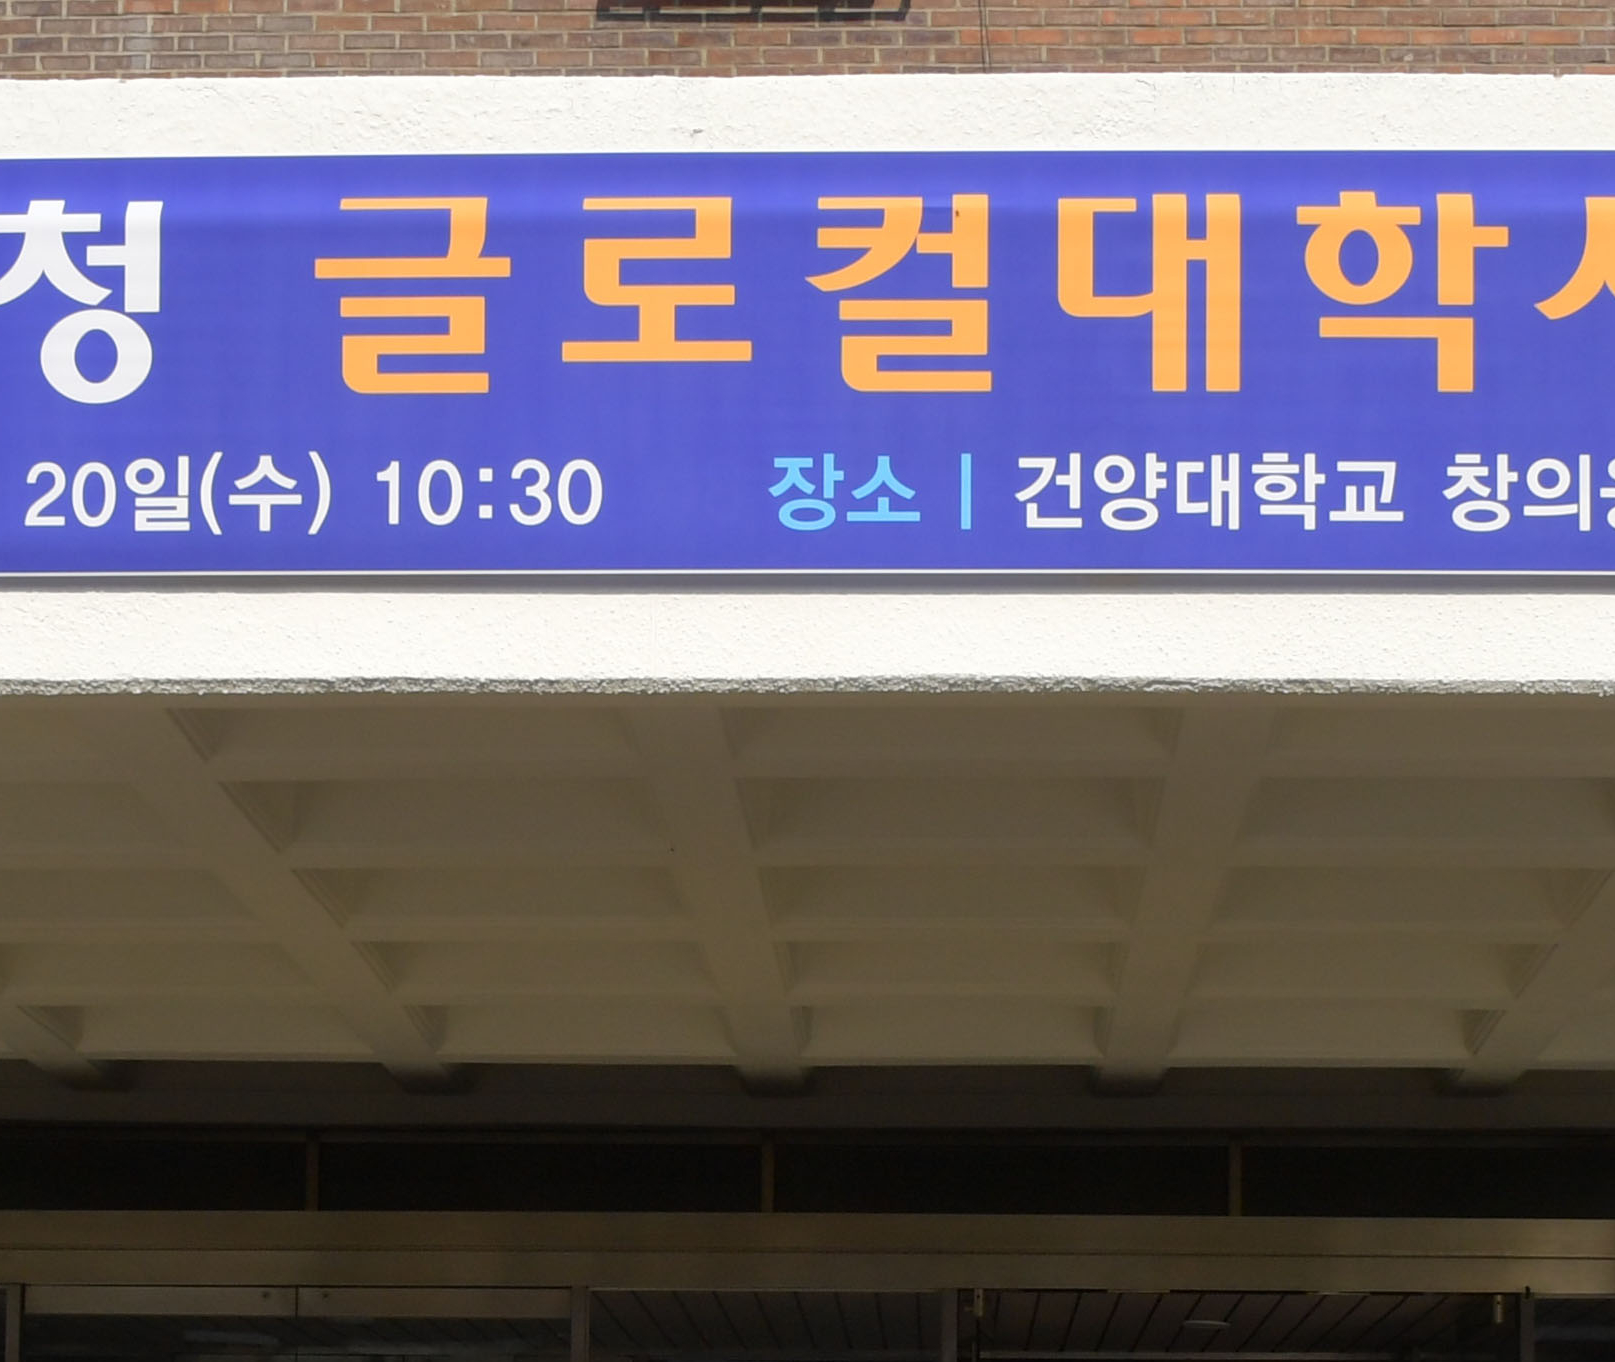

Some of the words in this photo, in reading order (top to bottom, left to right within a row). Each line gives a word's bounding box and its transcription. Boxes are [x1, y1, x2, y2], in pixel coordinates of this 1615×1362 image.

[23, 450, 332, 536] 20일(수)
[376, 458, 603, 527] 10:30
[768, 452, 921, 531] 장소
[1014, 452, 1405, 532] 건양대학교
